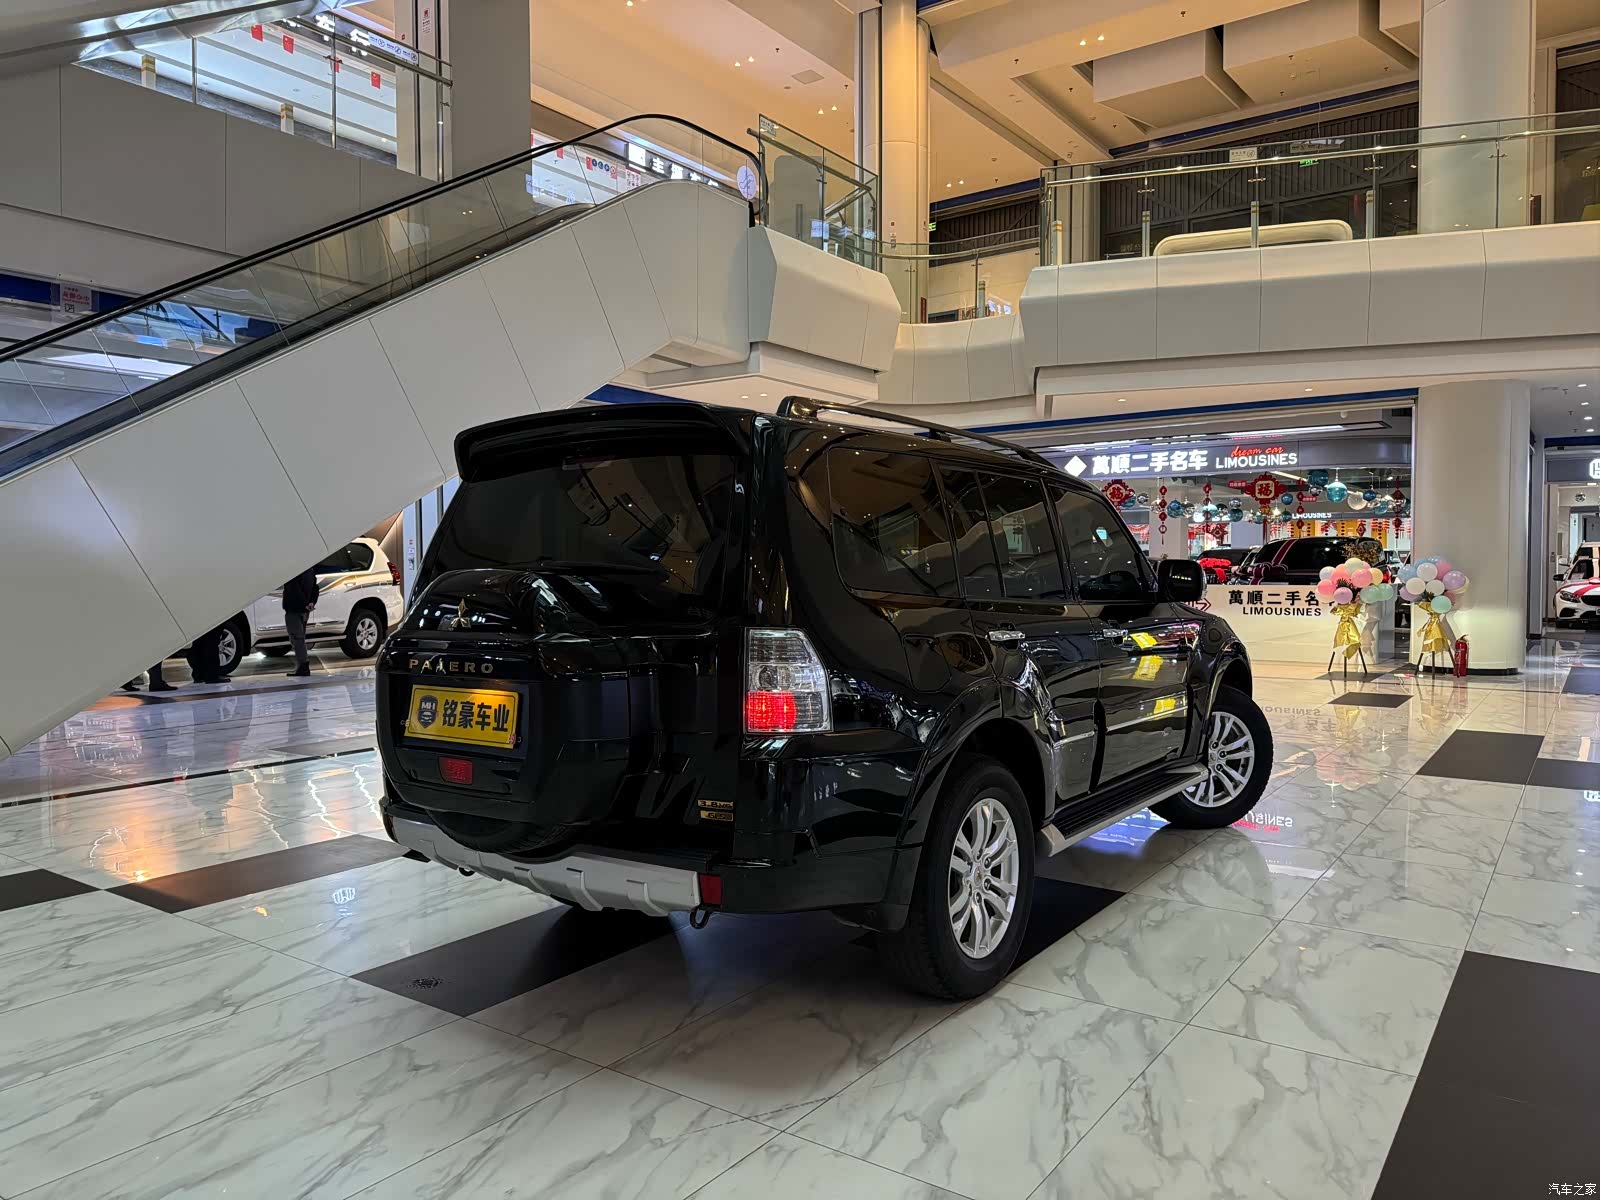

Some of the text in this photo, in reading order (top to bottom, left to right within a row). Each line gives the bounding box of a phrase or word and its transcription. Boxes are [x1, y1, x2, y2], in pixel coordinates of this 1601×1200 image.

[1231, 446, 1284, 457] dream car
[1091, 449, 1208, 475] 萬順二手名车
[1215, 453, 1298, 469] LIMOUSINES
[1228, 590, 1335, 607] 萬順二手名
[1242, 606, 1322, 616] LIMOUSINES
[421, 701, 436, 709] MH
[442, 699, 510, 732] 铭豪车业
